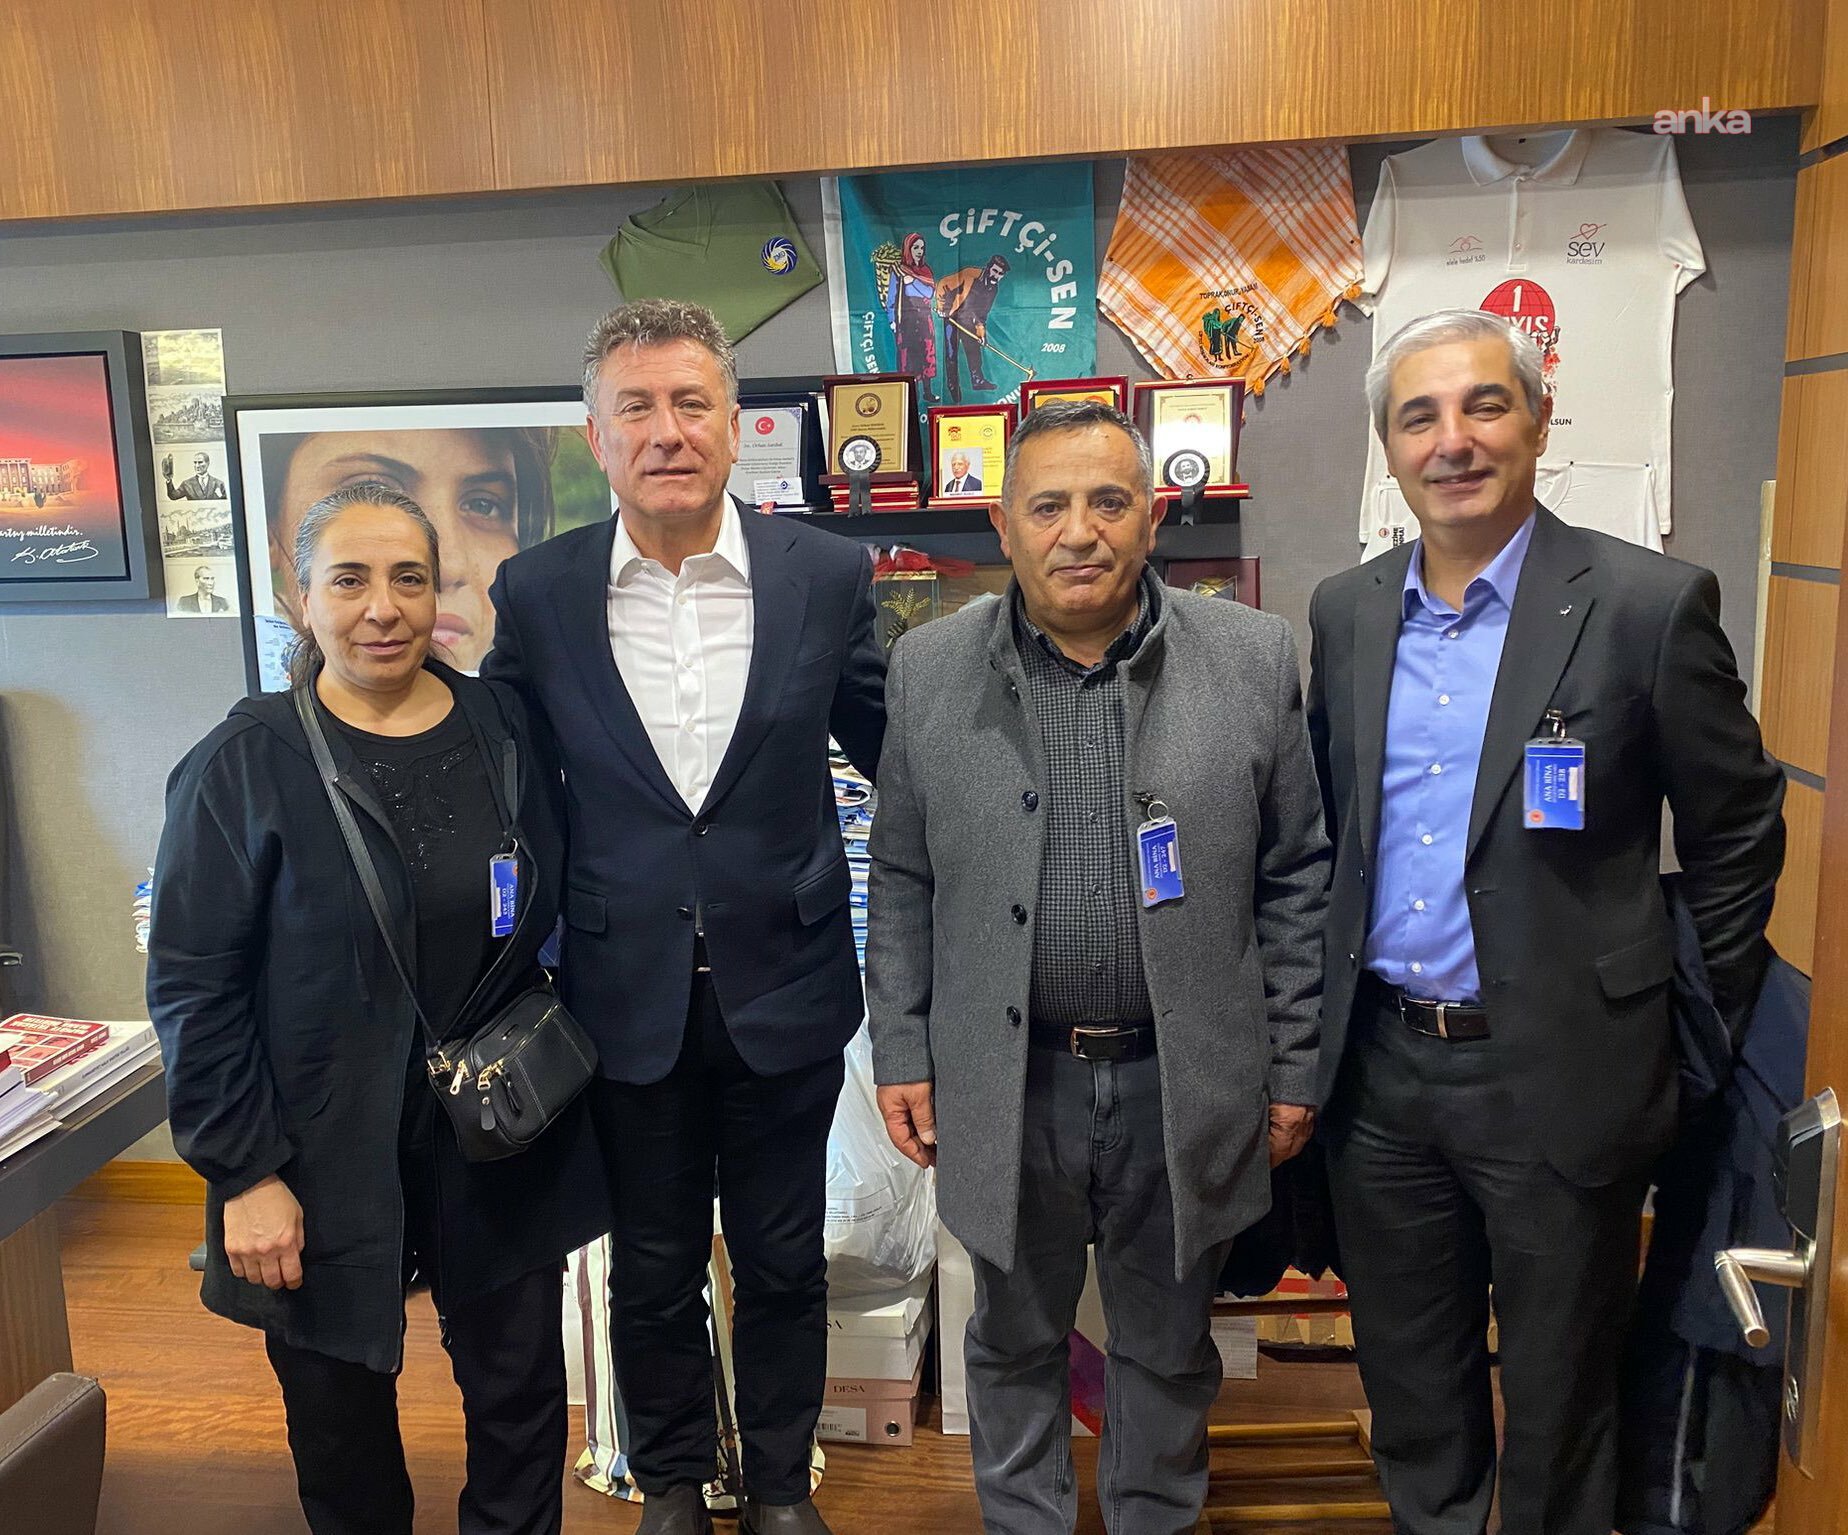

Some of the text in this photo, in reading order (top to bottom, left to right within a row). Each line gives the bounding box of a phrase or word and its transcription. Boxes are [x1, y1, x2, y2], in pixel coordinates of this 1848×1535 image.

[1567, 241, 1605, 257] sev
[1513, 285, 1523, 312] 1
[1041, 343, 1066, 353] 2008
[1544, 785, 1552, 803] ANA
[833, 1385, 865, 1393] DESA
